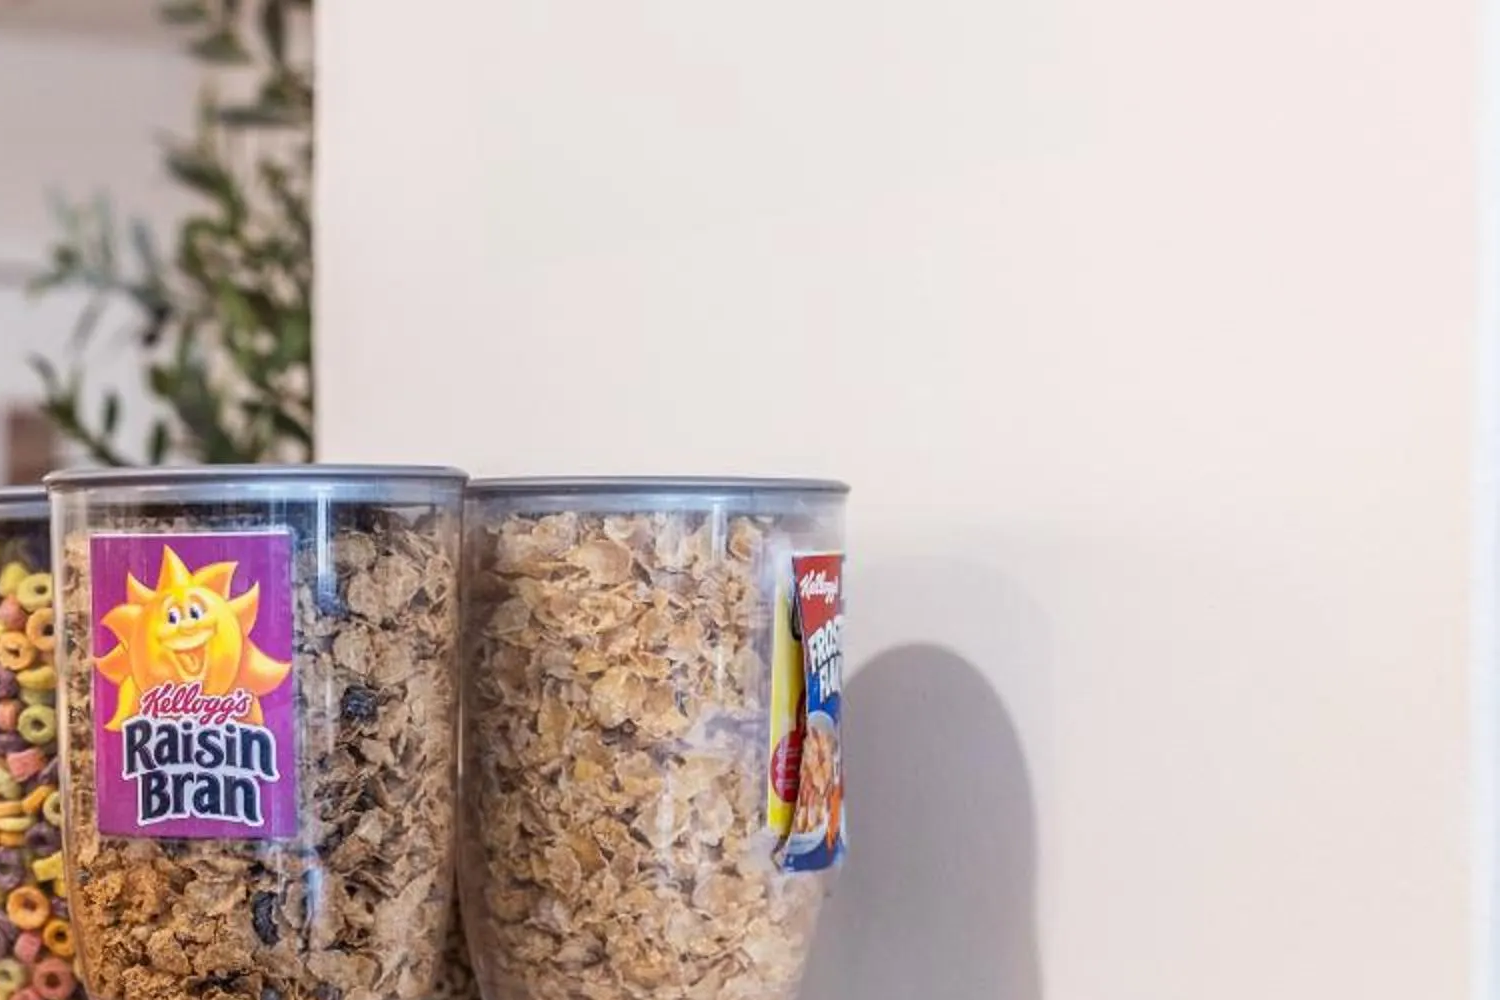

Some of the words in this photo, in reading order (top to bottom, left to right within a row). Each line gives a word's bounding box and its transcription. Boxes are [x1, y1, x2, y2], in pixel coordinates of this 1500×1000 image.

[142, 682, 251, 725] Kellogg's
[124, 718, 275, 778] Raisin
[140, 769, 261, 823] Bran
